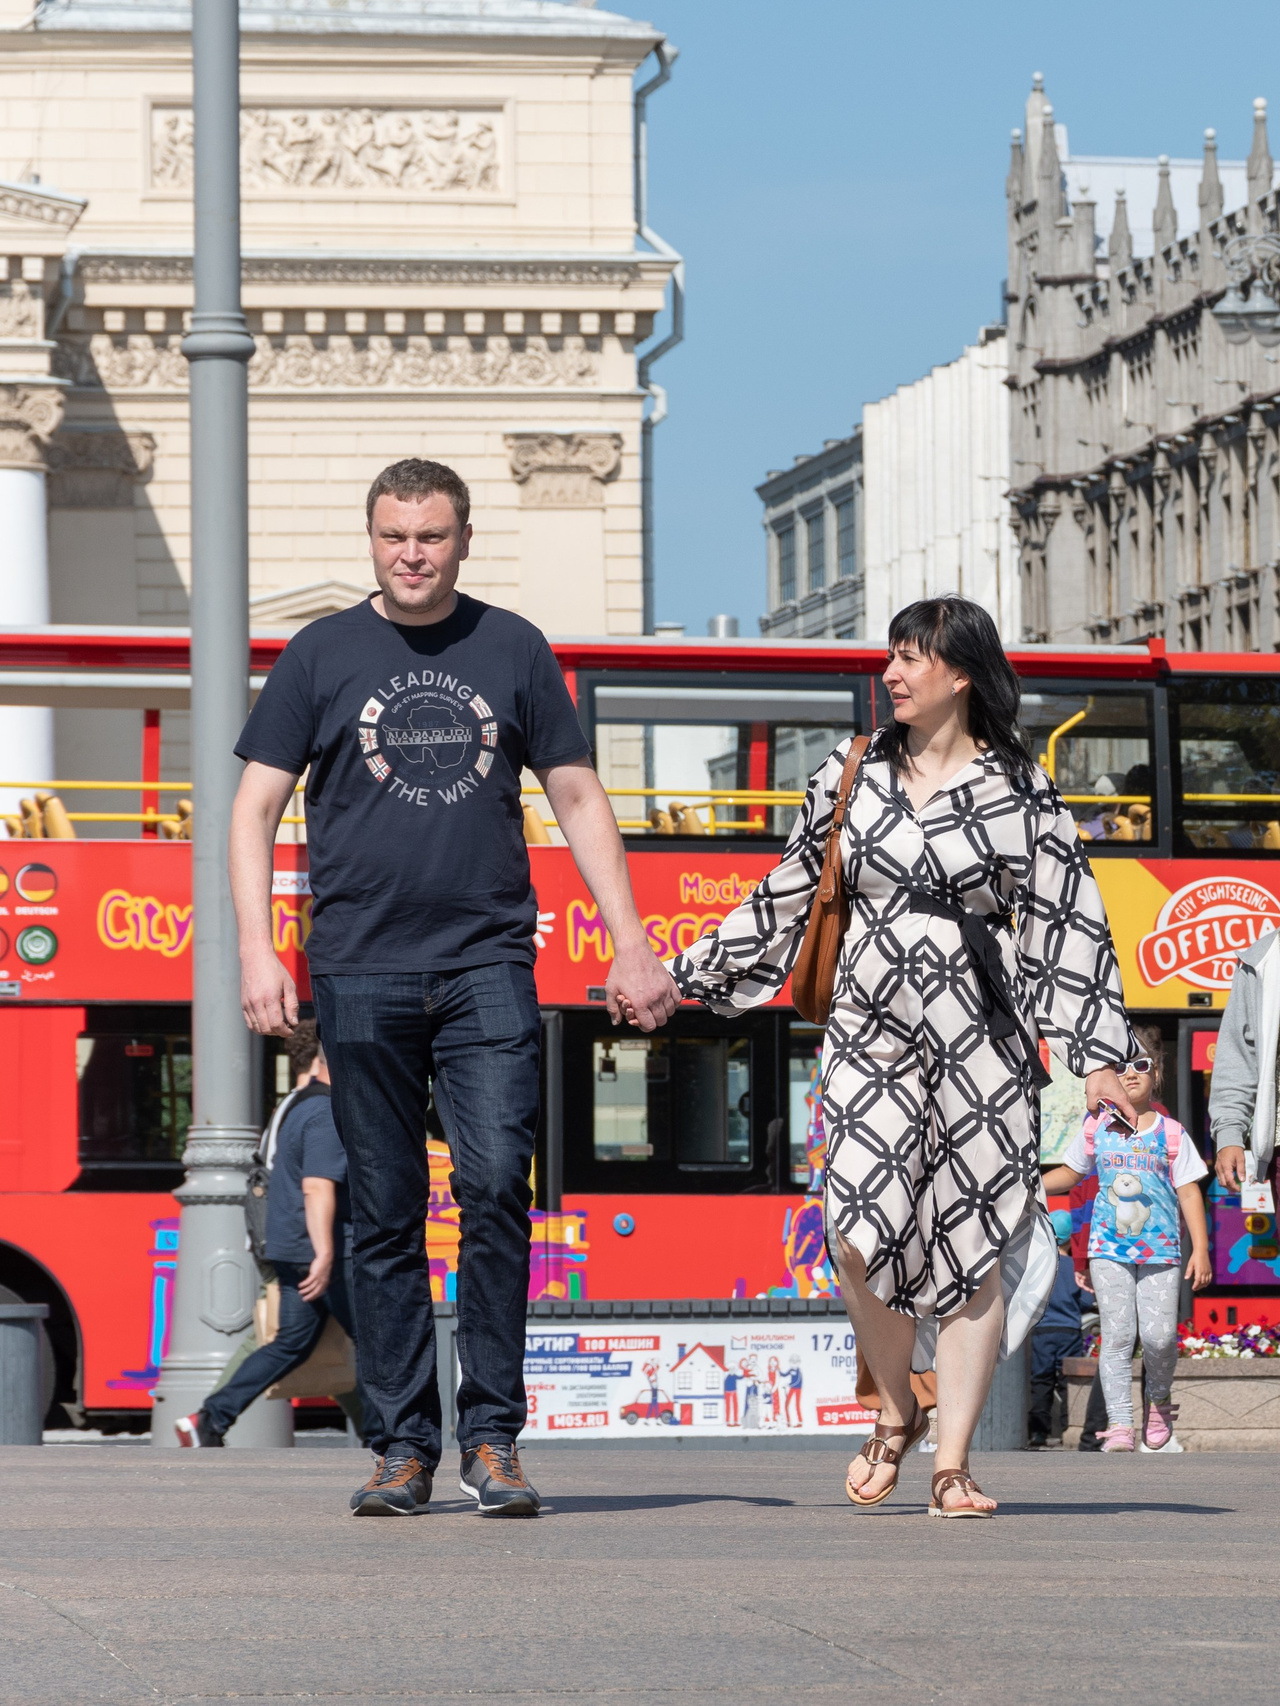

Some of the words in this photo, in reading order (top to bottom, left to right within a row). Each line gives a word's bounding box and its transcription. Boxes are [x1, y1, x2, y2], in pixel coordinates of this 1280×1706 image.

[378, 670, 472, 700] LEADING
[411, 691, 438, 700] MAPPING
[439, 693, 464, 711] SURVEYS
[387, 728, 471, 745] NAPAPIJRI
[388, 776, 430, 806] THE
[437, 771, 479, 805] WAY
[1175, 896, 1197, 920] CITY
[1196, 884, 1269, 911] SIGHTSEEING
[1102, 1151, 1157, 1171] SOCHI
[584, 1339, 606, 1351] 100
[608, 1338, 654, 1350] МАШИН
[811, 1334, 857, 1351] 17.0
[553, 1414, 605, 1427] MOS.RU
